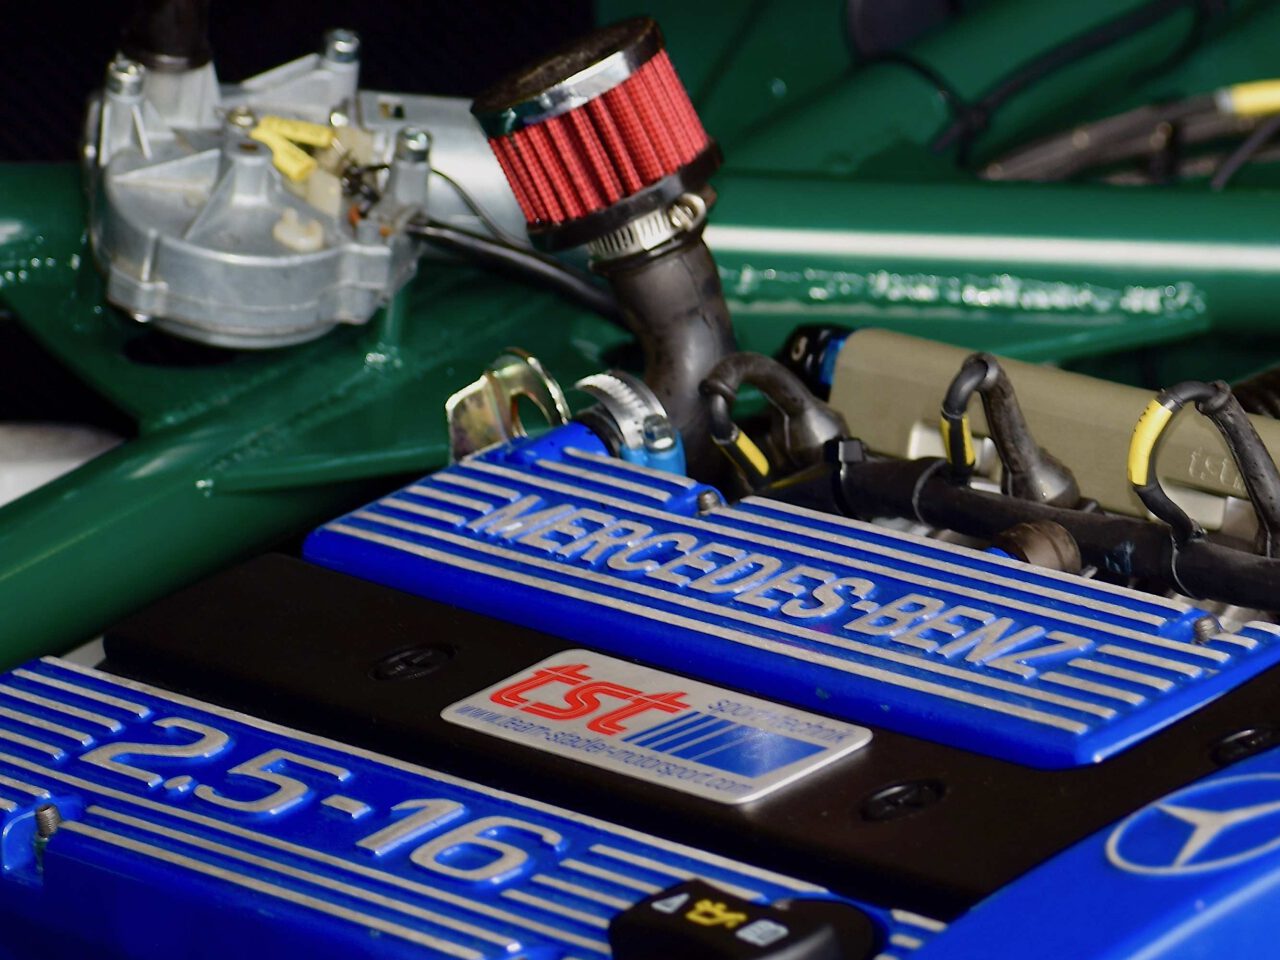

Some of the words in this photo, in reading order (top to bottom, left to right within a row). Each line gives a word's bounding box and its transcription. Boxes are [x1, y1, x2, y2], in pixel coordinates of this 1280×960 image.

[465, 494, 1095, 679] MERCEDES-BENZ
[489, 664, 692, 736] tst
[80, 716, 564, 886] 2.5-16
